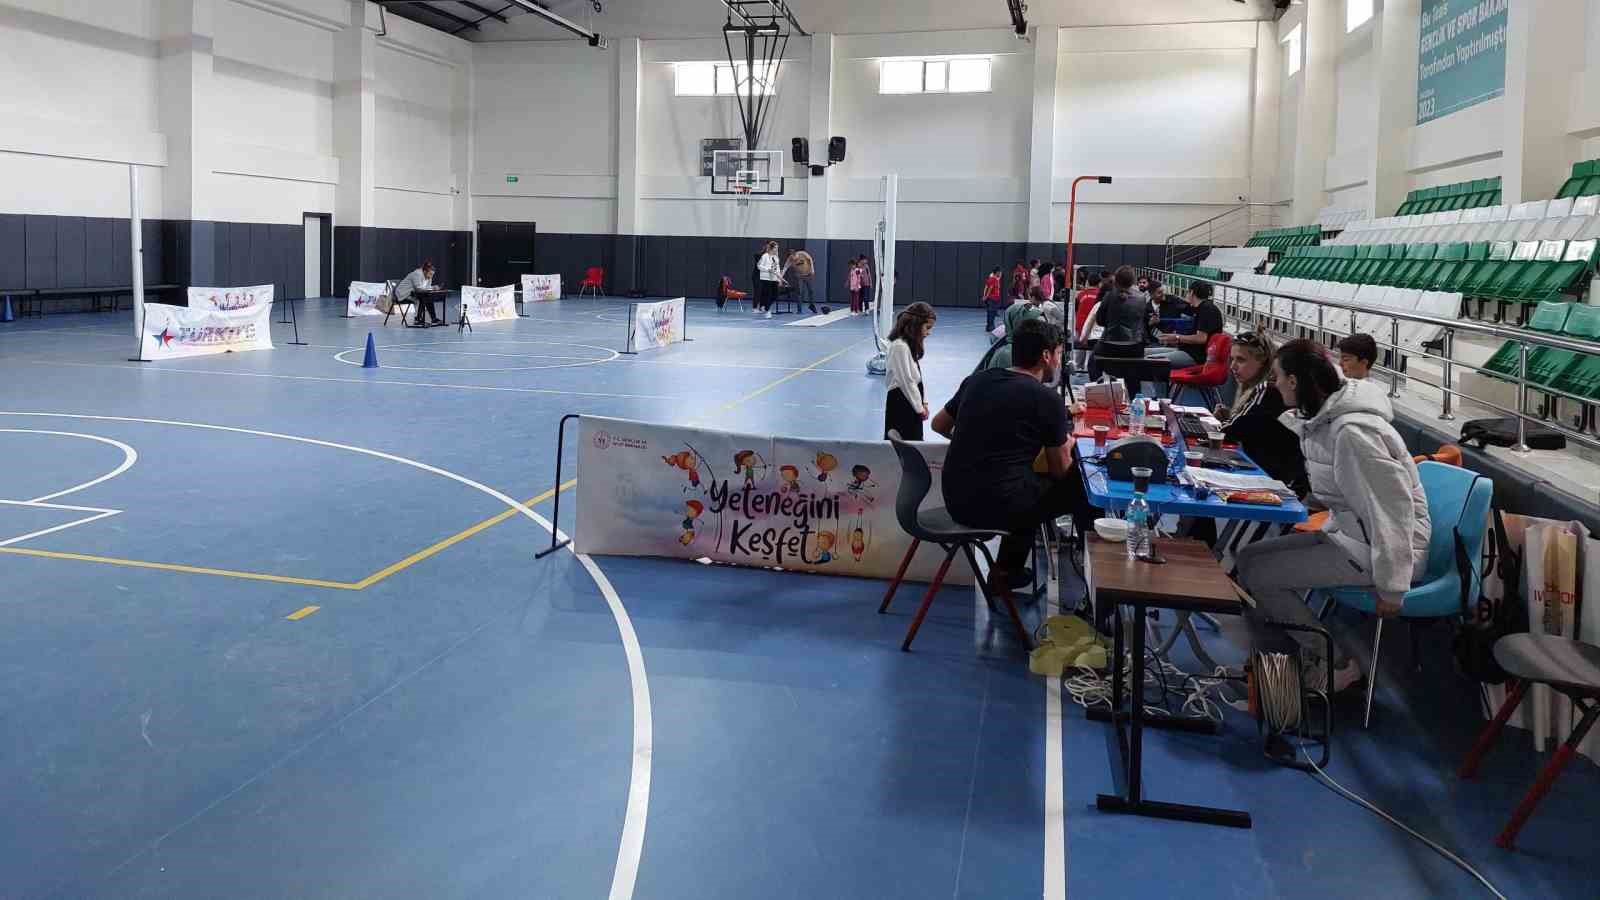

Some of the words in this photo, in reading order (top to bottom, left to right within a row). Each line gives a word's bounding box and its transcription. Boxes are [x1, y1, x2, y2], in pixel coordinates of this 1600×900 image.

[1447, 19, 1457, 41] VE
[1457, 7, 1478, 35] SPOR
[1419, 97, 1435, 120] 2023
[709, 480, 840, 528] Yeteneğini
[730, 520, 827, 564] Keşfet
